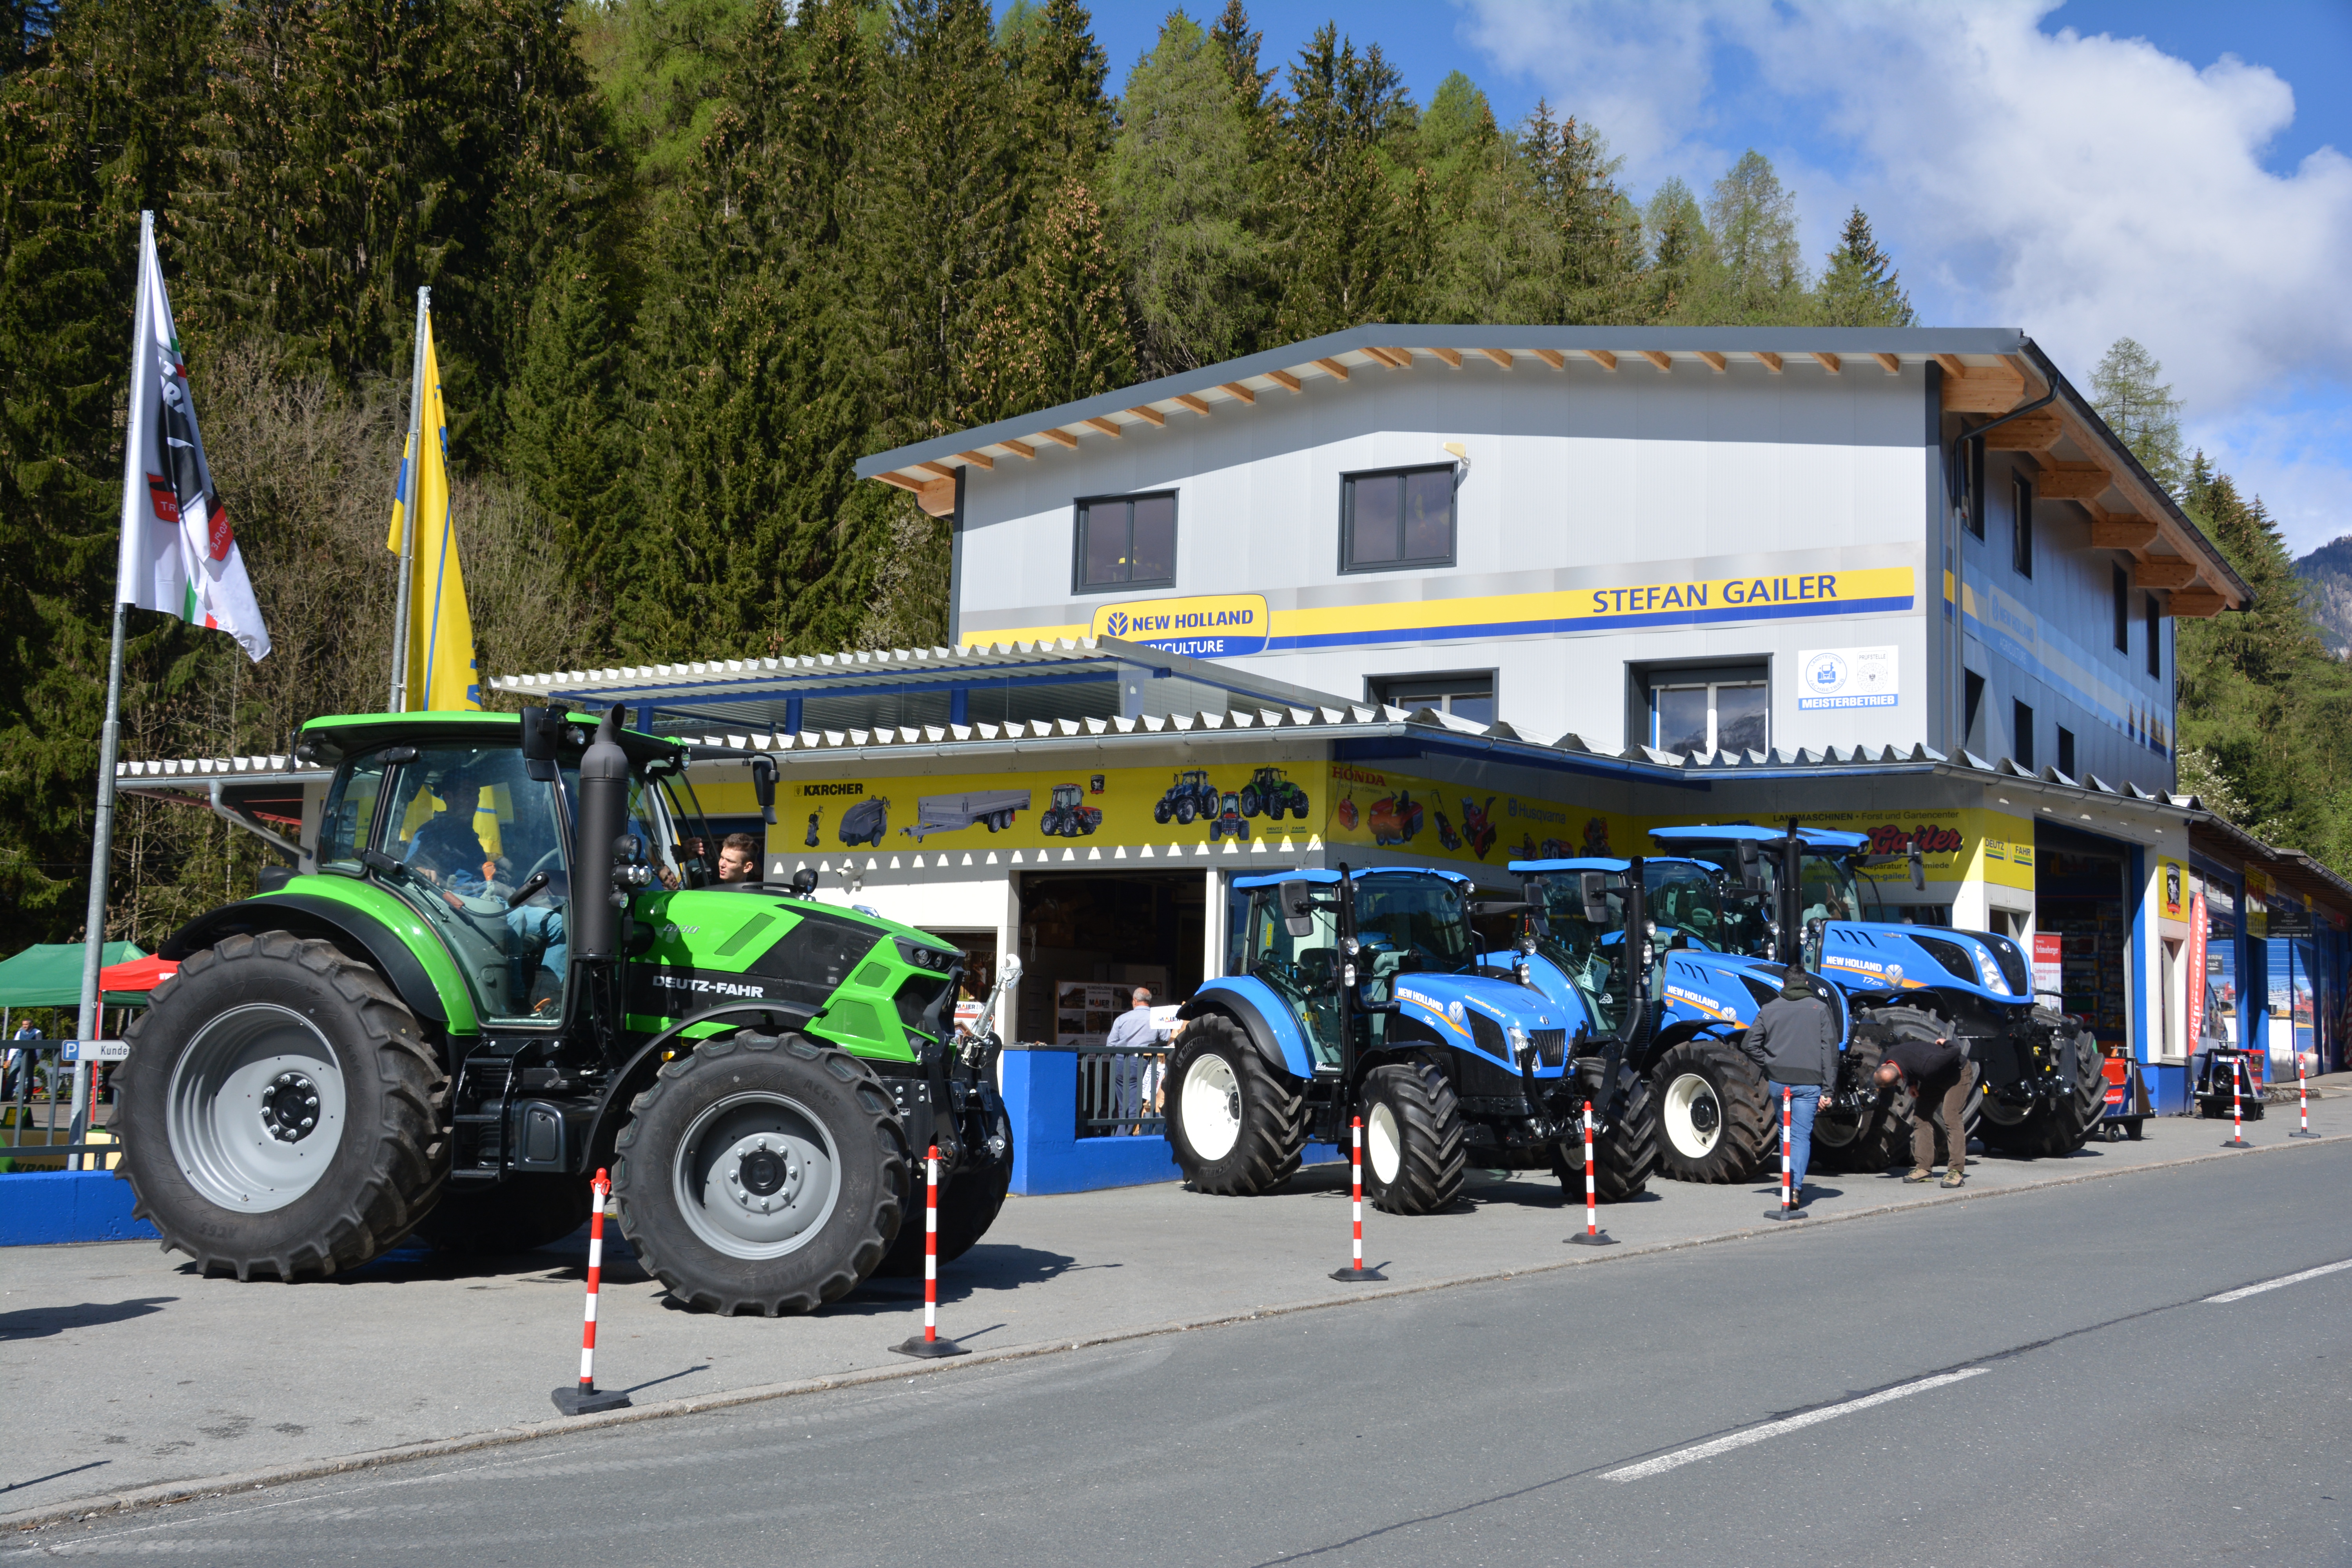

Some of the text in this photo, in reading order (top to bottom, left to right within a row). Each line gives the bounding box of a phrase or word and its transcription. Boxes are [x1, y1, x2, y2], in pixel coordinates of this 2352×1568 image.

[1593, 574, 1837, 613] STEFAN GAILER
[1132, 609, 1254, 631] NEW HOLLAND
[1145, 640, 1224, 654] ICULTURE
[1810, 655, 1843, 667] LANDTECHNIK
[1809, 678, 1844, 692] FACHBETRIEB
[1802, 695, 1895, 708] MEISTERBETRIEB
[1332, 766, 1387, 787] HONDA
[804, 783, 863, 796] KÄRCHER
[1519, 802, 1566, 824] Husqvarna
[1773, 813, 1853, 822] LANMASCHINEN
[1867, 824, 1963, 855] Gailer
[1985, 838, 2031, 857] DEUTZ FAHR
[663, 924, 701, 934] 6130
[1826, 955, 1882, 973] NEW HOLLAND
[652, 975, 764, 998] DEUTZ-FAHR
[1089, 998, 1109, 1007] MAIER
[1398, 987, 1443, 1012] NEW HOLLAND
[1667, 985, 1719, 1009] NEW HOLLAND
[66, 1043, 77, 1058] P
[803, 1079, 840, 1107] AC65
